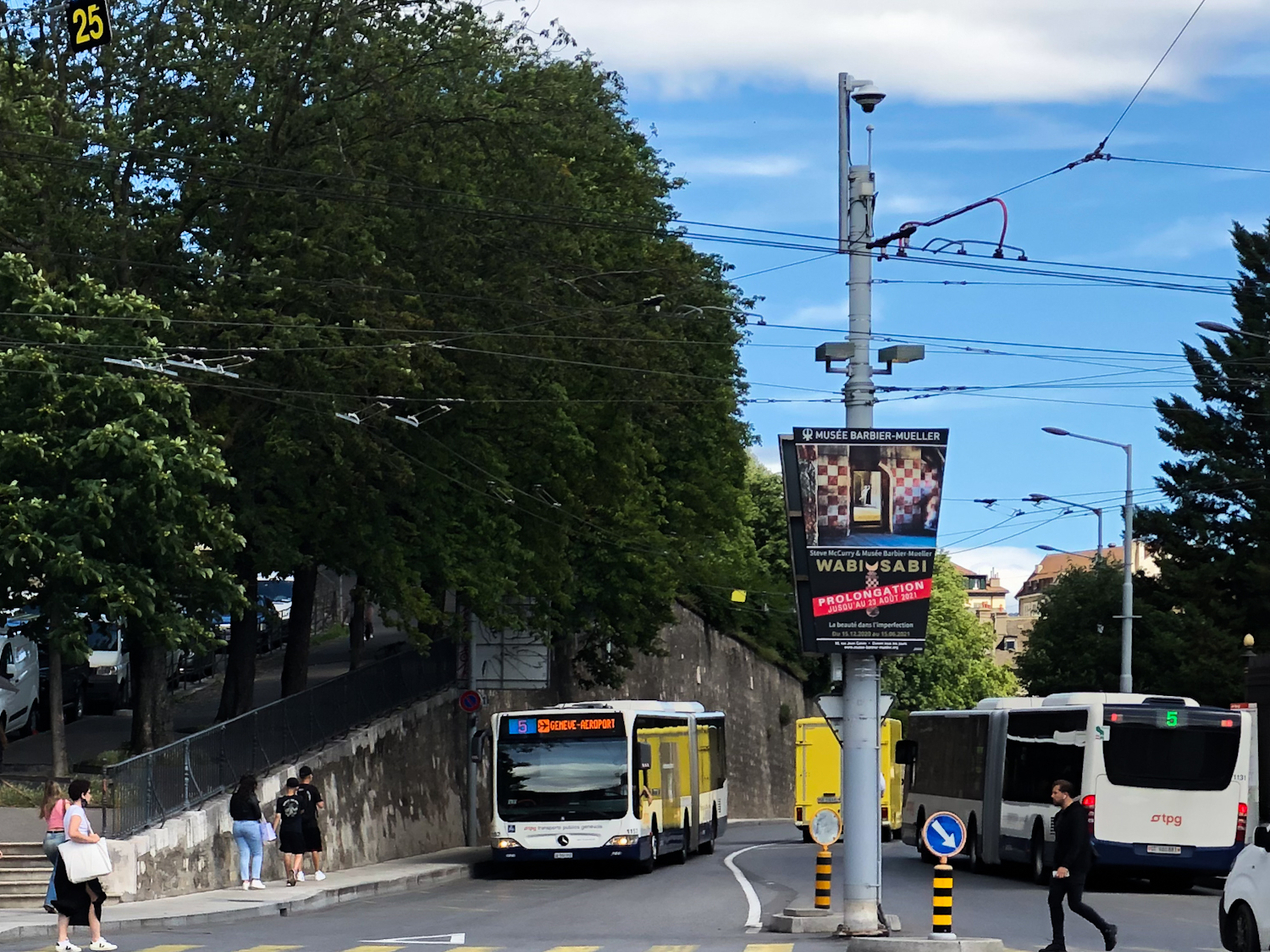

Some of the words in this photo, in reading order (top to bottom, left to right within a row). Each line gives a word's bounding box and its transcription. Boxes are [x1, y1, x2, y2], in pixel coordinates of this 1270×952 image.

[72, 3, 104, 45] 25
[815, 429, 848, 440] MUSÉE
[850, 430, 940, 441] BARBIER-MUELLER
[810, 549, 827, 557] Steve
[828, 549, 855, 558] McCurry
[862, 548, 882, 557] Musée
[883, 549, 932, 557] Barbier-Mueller
[816, 559, 863, 572] WABI
[880, 559, 927, 573] SABI
[818, 580, 925, 607] PROLONGATION
[827, 600, 866, 613] JUSQU'AU
[901, 591, 917, 600] 2021
[518, 719, 528, 733] 5
[550, 718, 616, 731] GENEVE-AEROPORT
[1166, 710, 1178, 727] 5
[1162, 813, 1182, 827] tpg
